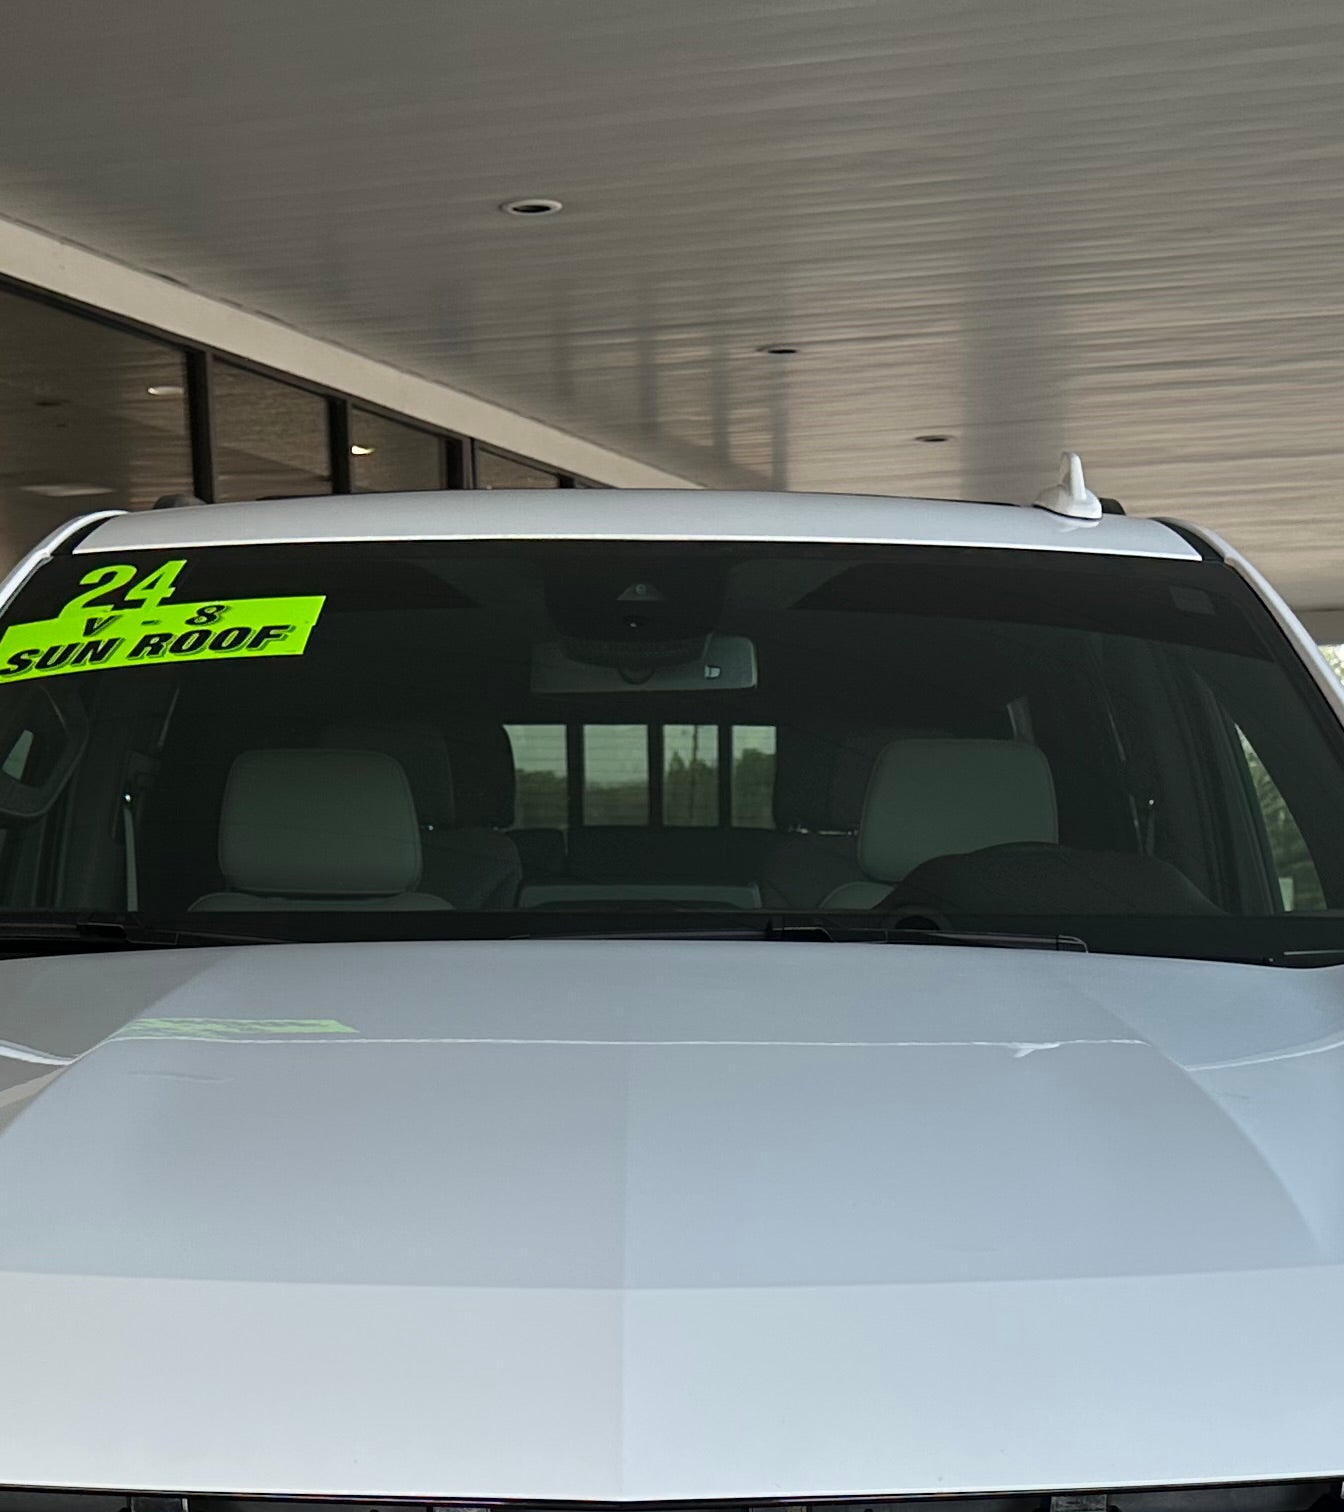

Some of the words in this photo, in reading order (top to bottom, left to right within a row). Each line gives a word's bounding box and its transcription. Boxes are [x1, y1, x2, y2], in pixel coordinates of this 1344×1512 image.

[58, 559, 187, 615] 24
[83, 614, 119, 636] V
[185, 605, 231, 626] 8
[129, 624, 293, 660] ROOF
